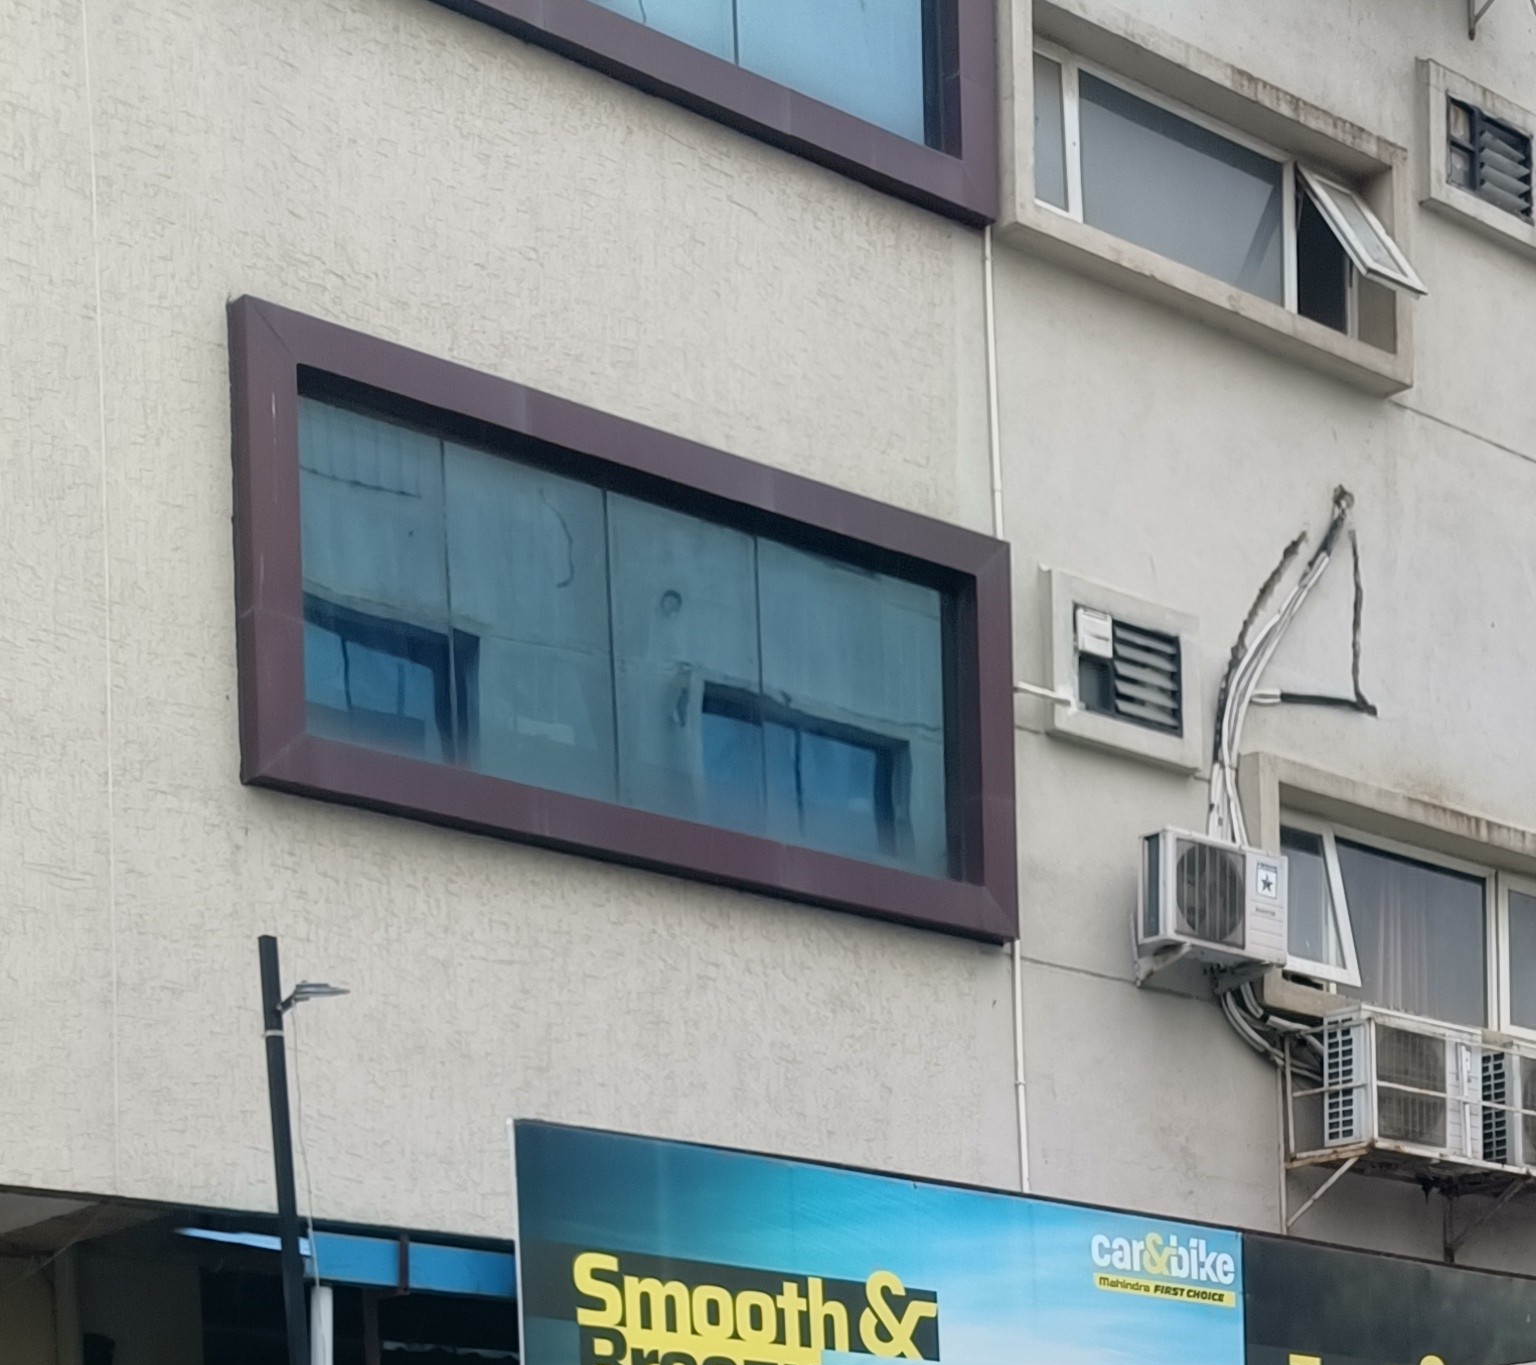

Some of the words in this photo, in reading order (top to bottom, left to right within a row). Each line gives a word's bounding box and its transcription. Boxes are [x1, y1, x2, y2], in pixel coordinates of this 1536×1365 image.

[1091, 1232, 1235, 1285] car&bike
[572, 1252, 848, 1353] Smooth
[859, 1270, 938, 1360] &
[1099, 1277, 1150, 1292] Mahindra
[1153, 1285, 1186, 1297] FIRST
[1186, 1288, 1225, 1302] CHOICE
